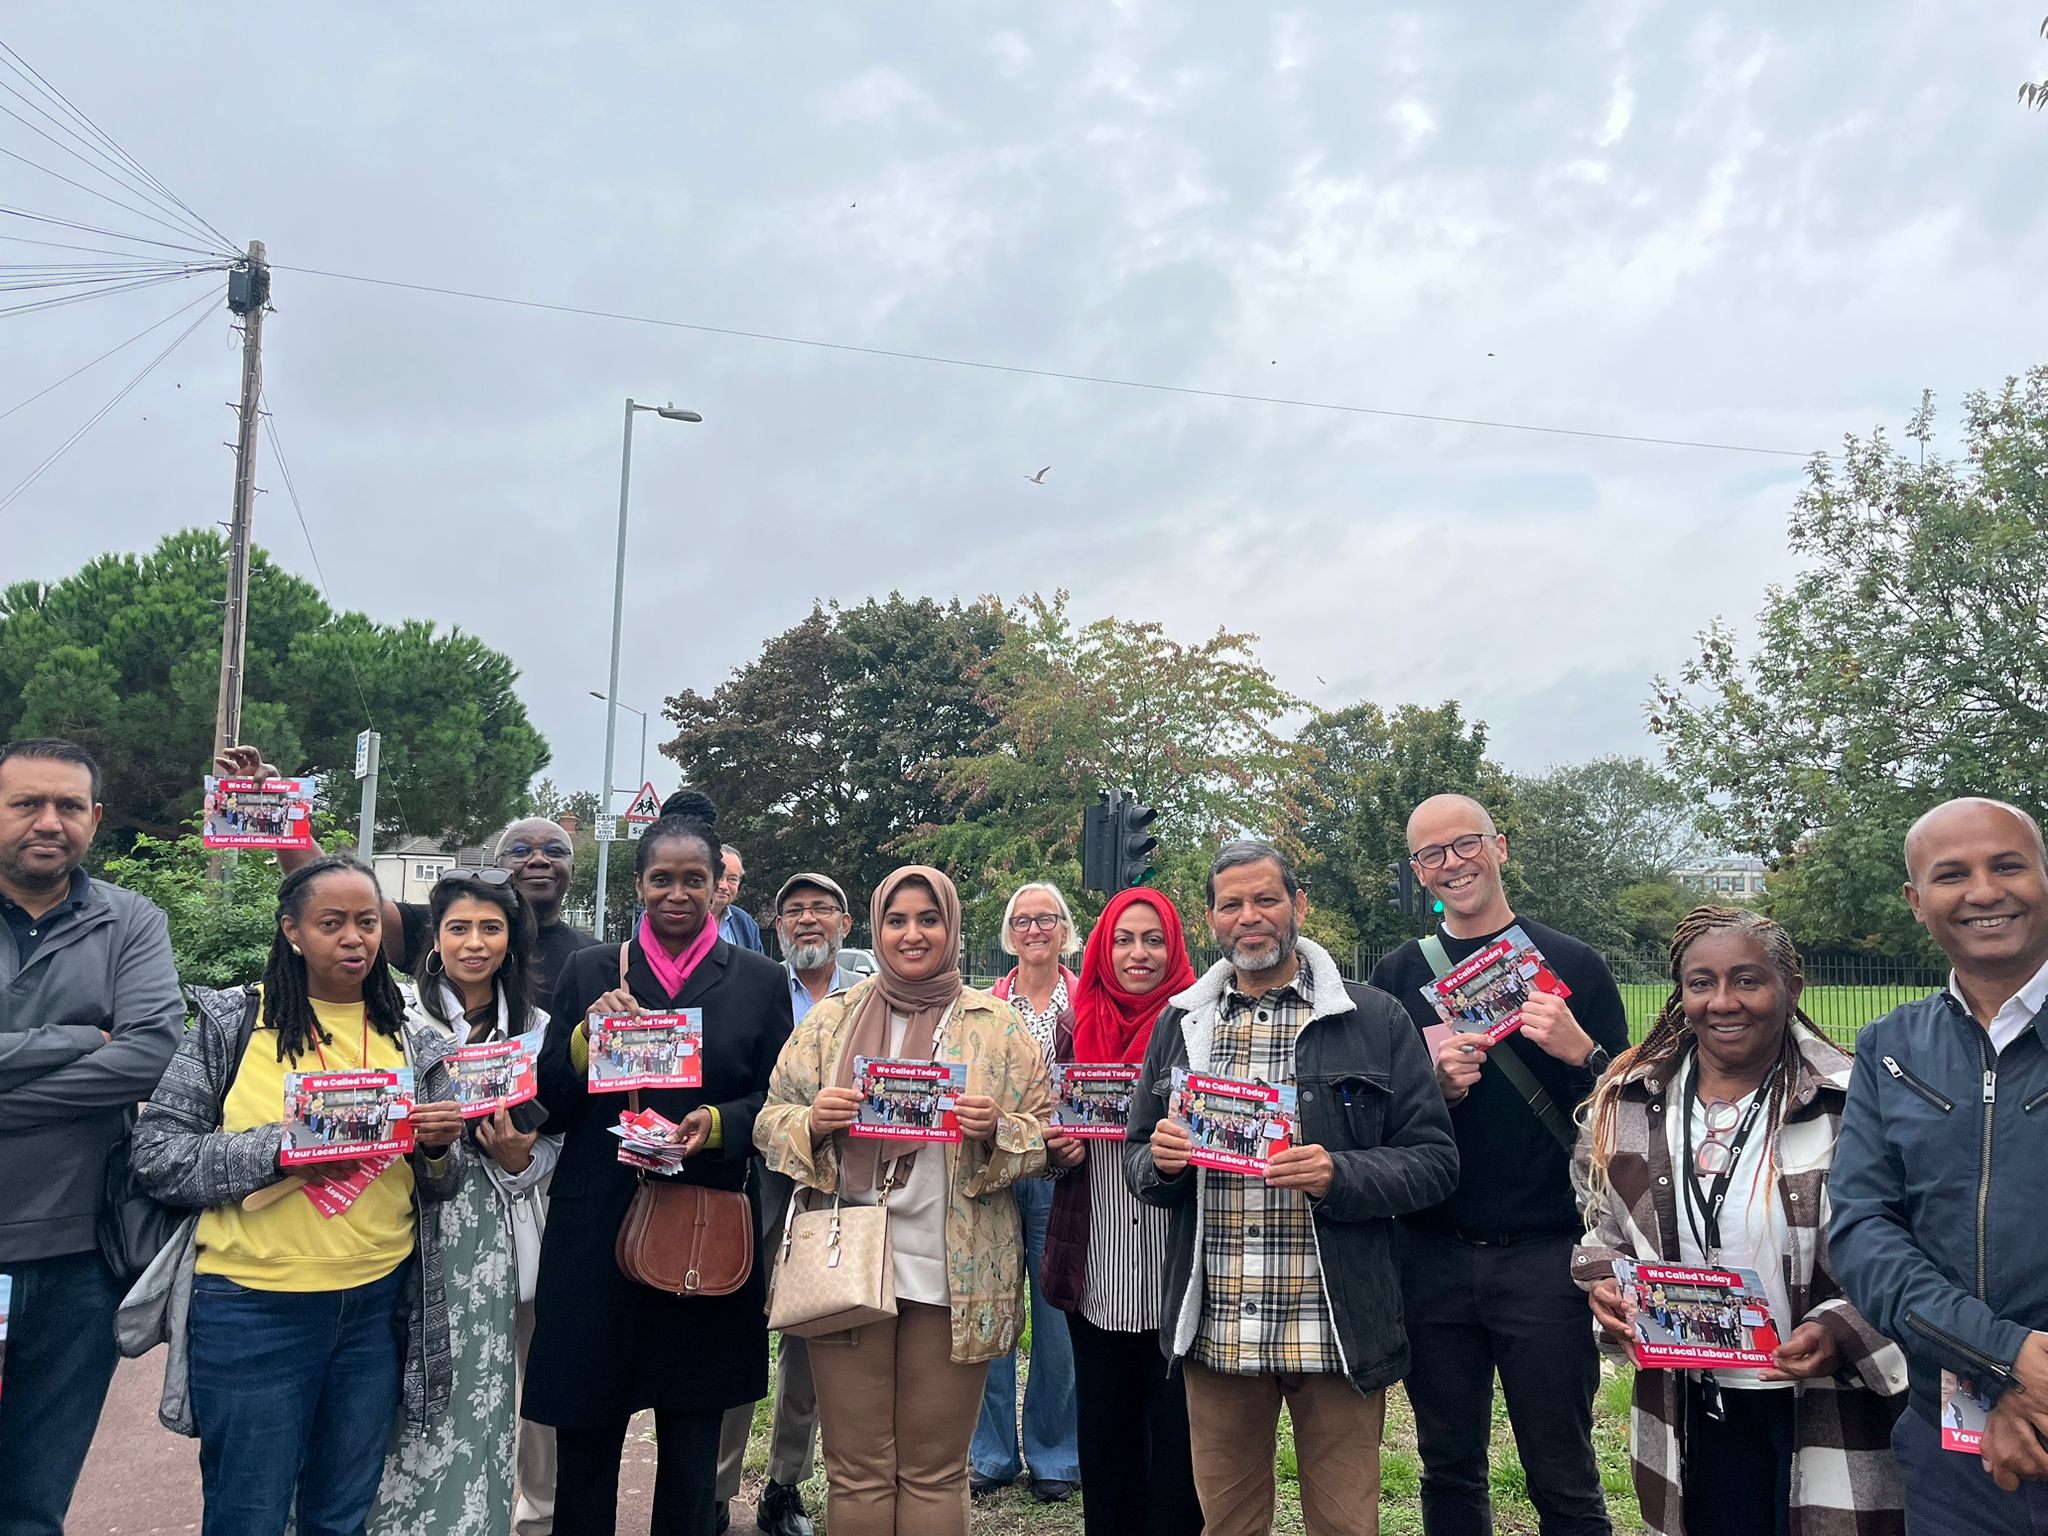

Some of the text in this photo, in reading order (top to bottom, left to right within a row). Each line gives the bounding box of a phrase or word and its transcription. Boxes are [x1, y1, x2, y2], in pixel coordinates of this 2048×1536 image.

[266, 783, 292, 791] Today
[229, 836, 251, 844] Local
[1444, 946, 1504, 988] We Called Today
[653, 1017, 679, 1026] Today
[463, 1049, 489, 1057] Called
[489, 1044, 513, 1054] Today
[876, 1066, 942, 1078] We Called Today
[1112, 1071, 1136, 1079] Today
[312, 1076, 389, 1088] We Called Today
[594, 1080, 614, 1088] Your
[637, 1077, 665, 1085] Labour
[1196, 1079, 1270, 1100] We Called Today
[855, 1124, 948, 1137] Your Local Labour Team
[287, 1141, 398, 1159] Your Local Labour Team
[1192, 1148, 1215, 1160] Local
[1216, 1152, 1248, 1166] Labour
[1647, 1270, 1731, 1286] We Called Today
[1642, 1345, 1767, 1362] Your Local Labour Team
